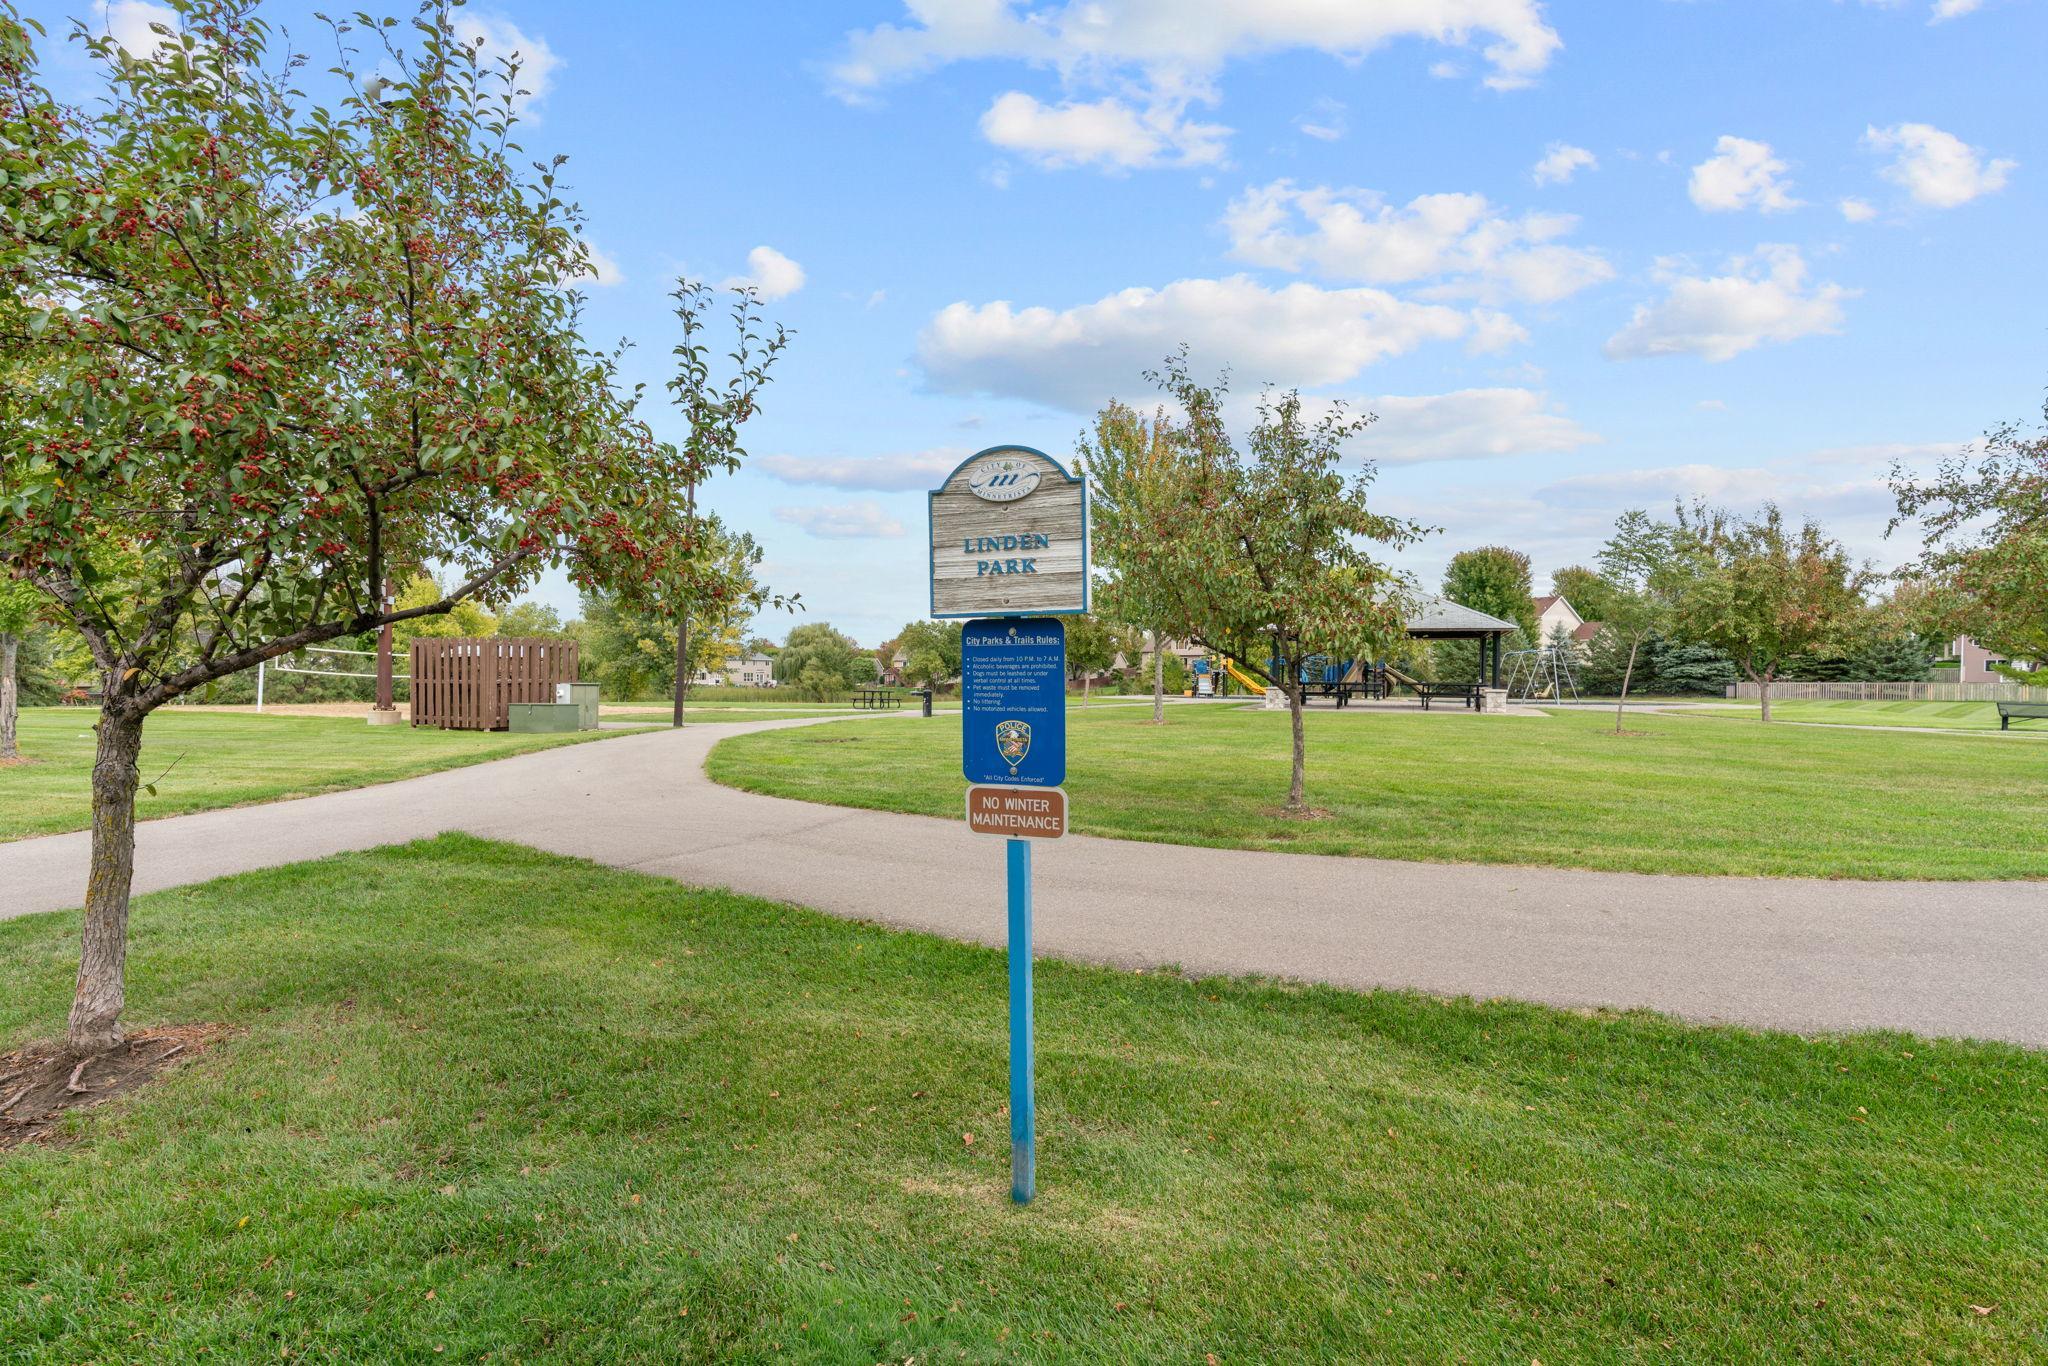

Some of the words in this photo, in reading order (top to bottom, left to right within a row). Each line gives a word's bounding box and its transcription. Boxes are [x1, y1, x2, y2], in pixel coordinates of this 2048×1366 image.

[980, 462, 1000, 472] CITY
[964, 533, 1050, 553] LINDEN
[977, 558, 1038, 576] PARK
[966, 636, 980, 646] City
[982, 636, 1003, 644] Parks
[1005, 636, 1012, 644] &
[1014, 636, 1034, 644] Trails
[1036, 636, 1060, 644] Rules:
[1000, 722, 1028, 732] POLICE
[982, 796, 1000, 809] NO
[1004, 798, 1050, 812] WINTER
[973, 813, 1060, 830] MAINTENANCE
